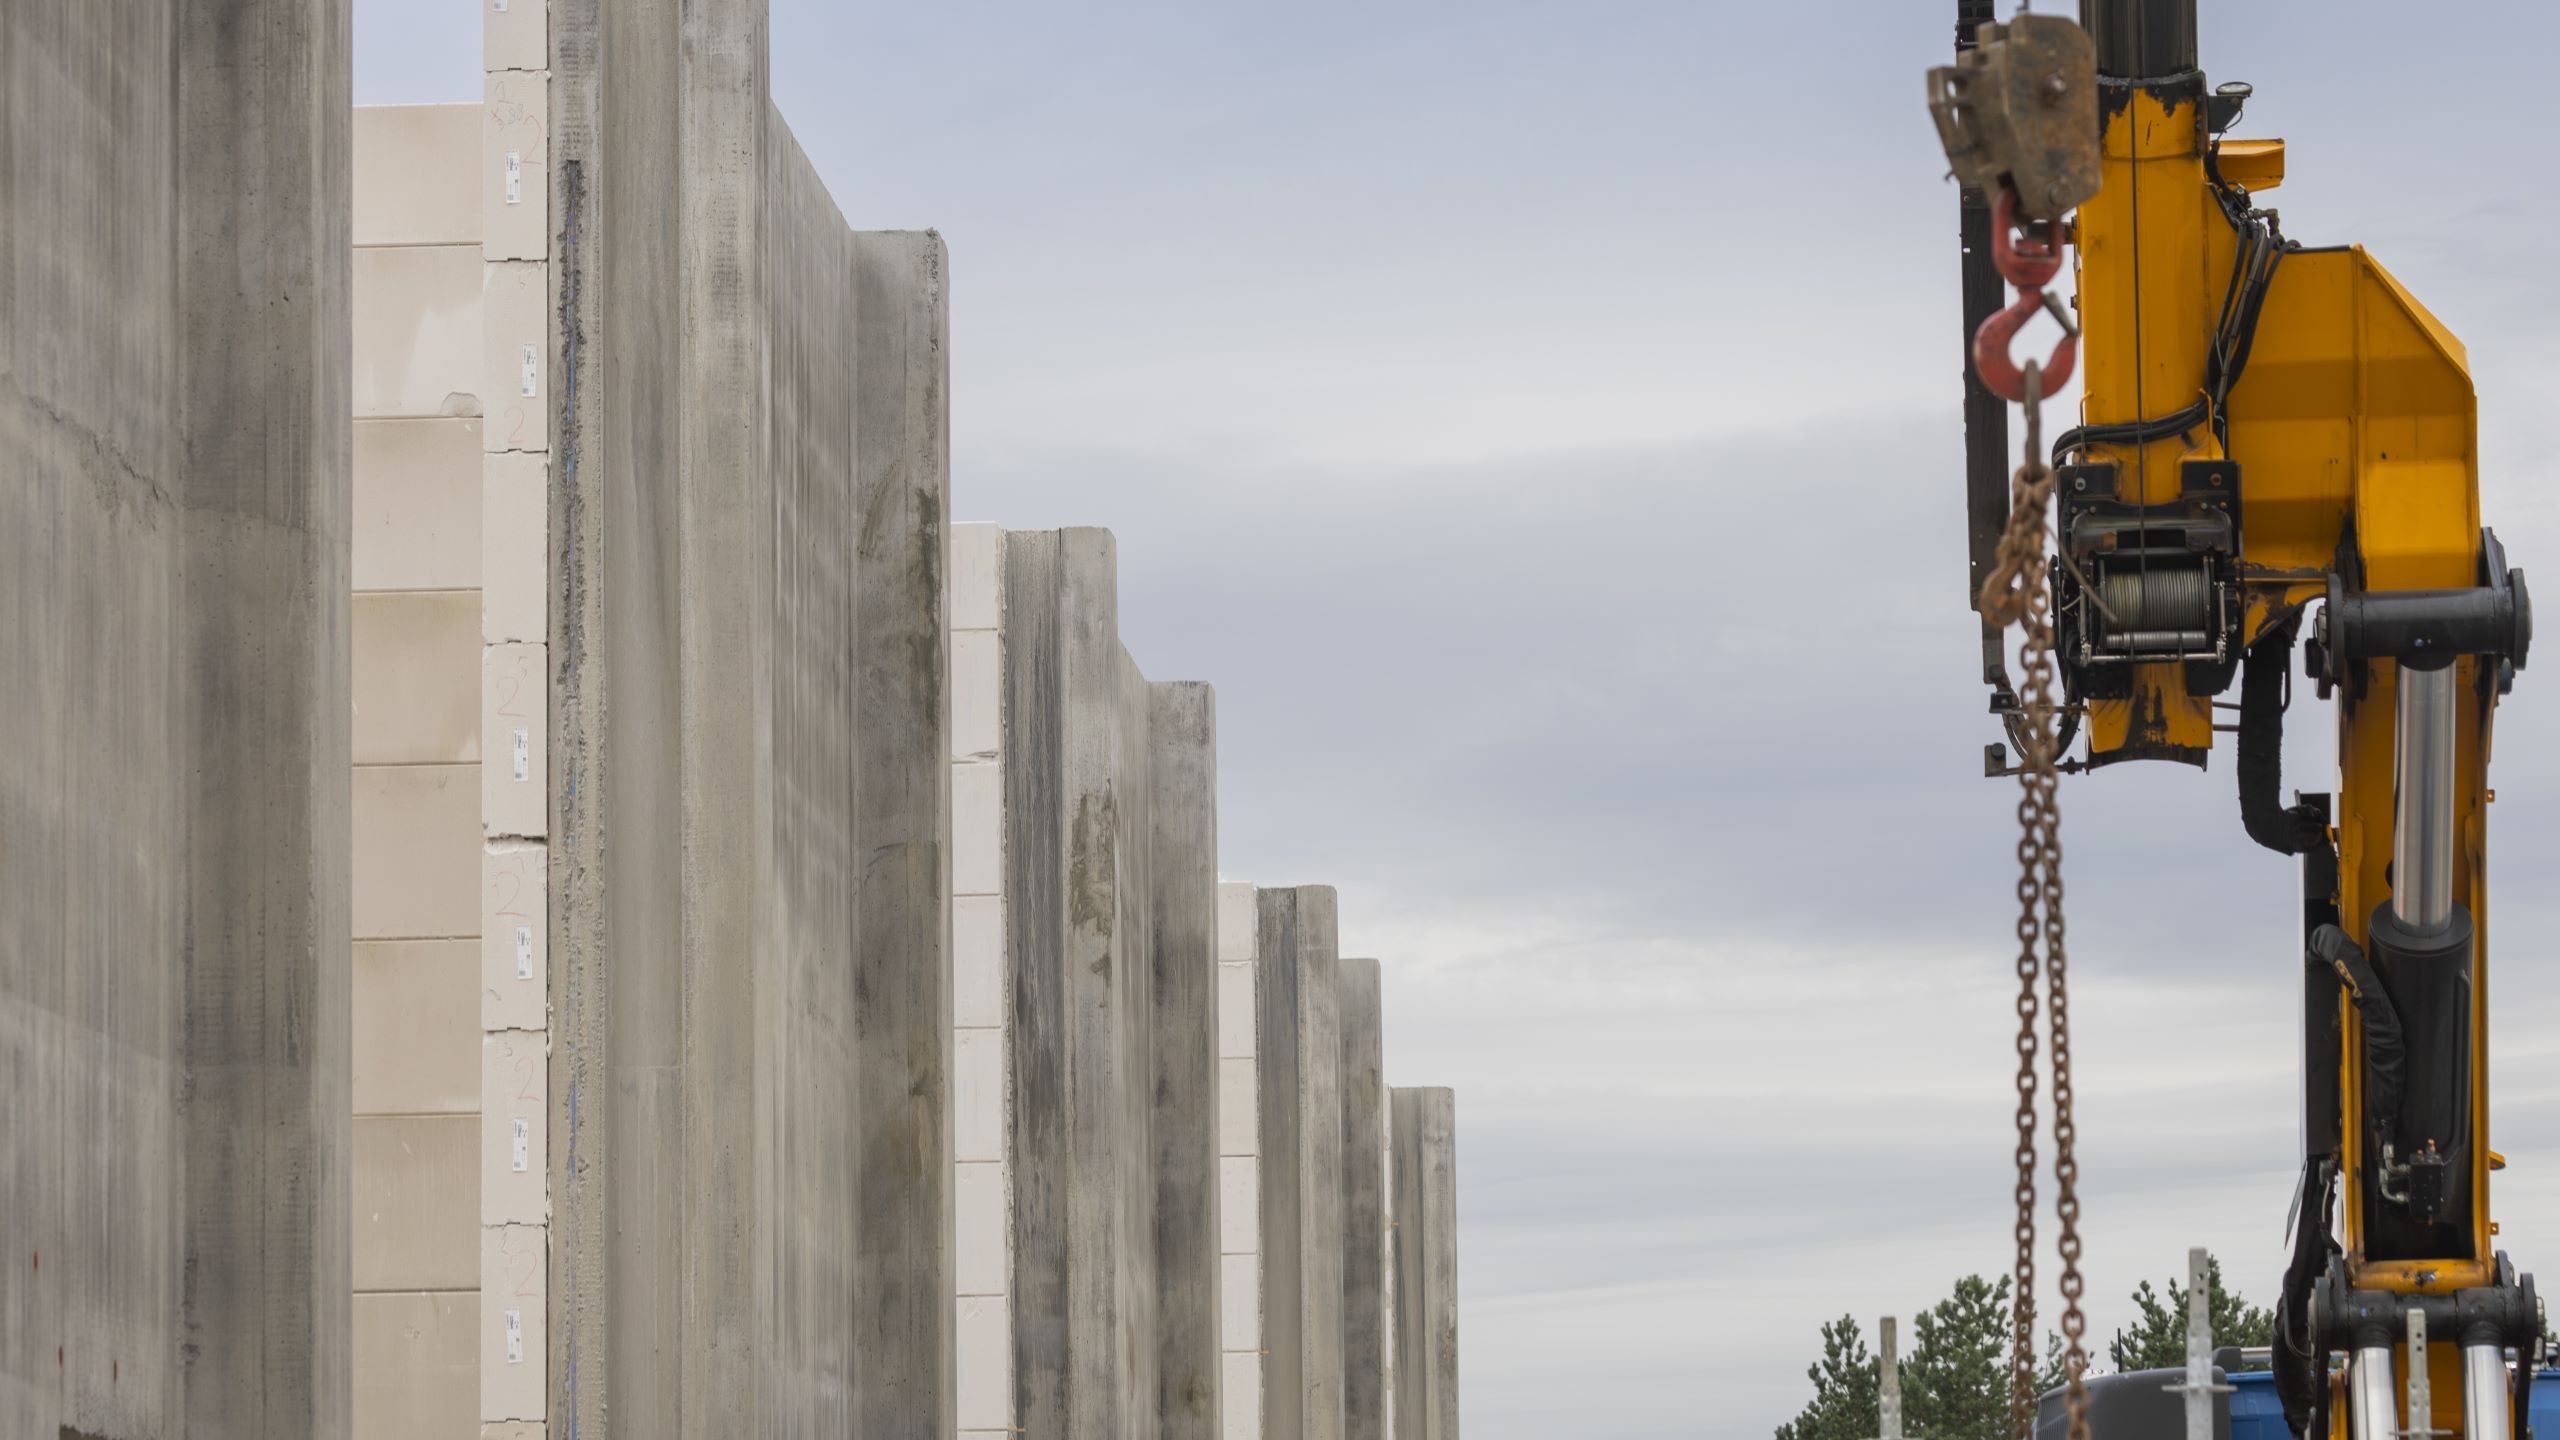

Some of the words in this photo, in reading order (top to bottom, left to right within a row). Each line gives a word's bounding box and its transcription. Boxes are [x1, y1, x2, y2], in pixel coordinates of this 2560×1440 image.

[521, 114, 543, 166] 2
[503, 406, 525, 444] 2
[496, 675, 529, 718] 2
[513, 1055, 543, 1105] 2
[509, 1248, 539, 1298] 2
